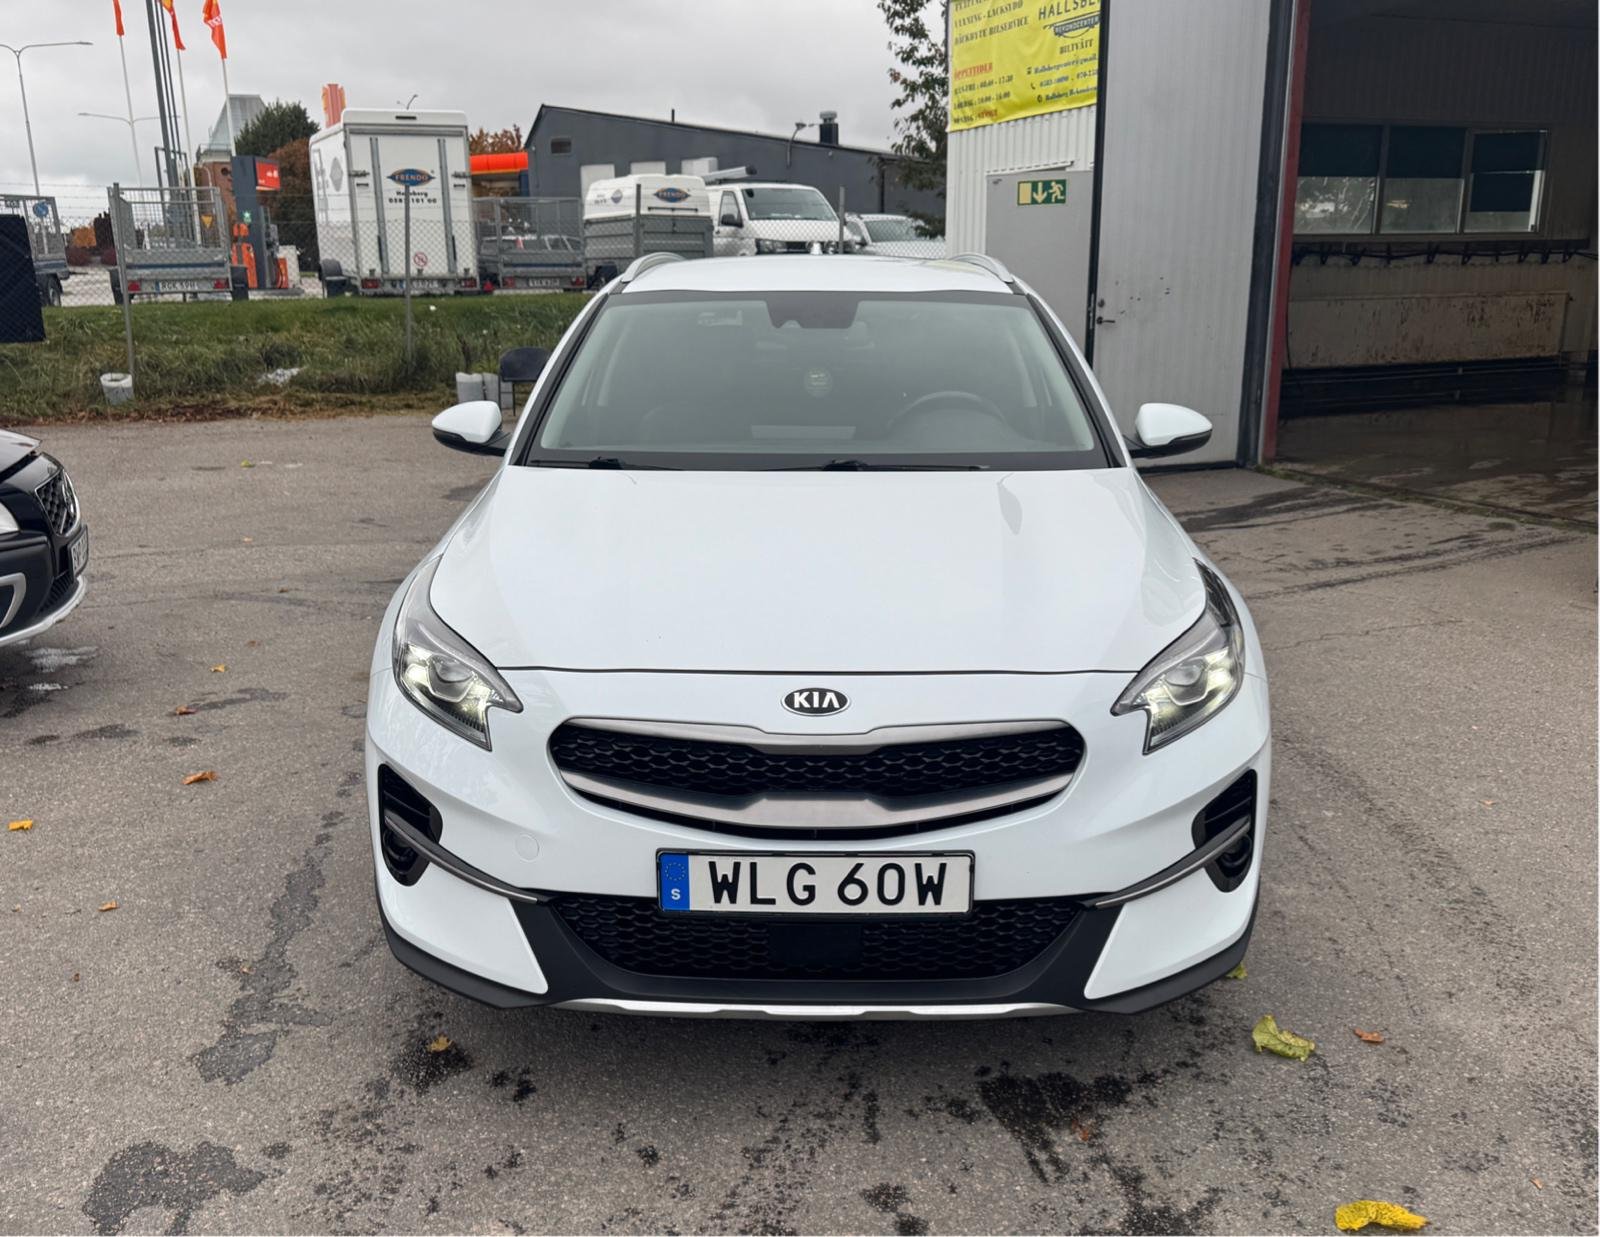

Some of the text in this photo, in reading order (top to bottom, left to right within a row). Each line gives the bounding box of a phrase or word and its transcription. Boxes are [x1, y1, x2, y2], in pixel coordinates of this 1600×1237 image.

[793, 691, 840, 709] KIA
[709, 861, 947, 907] WLG 60W
[671, 889, 680, 900] S
